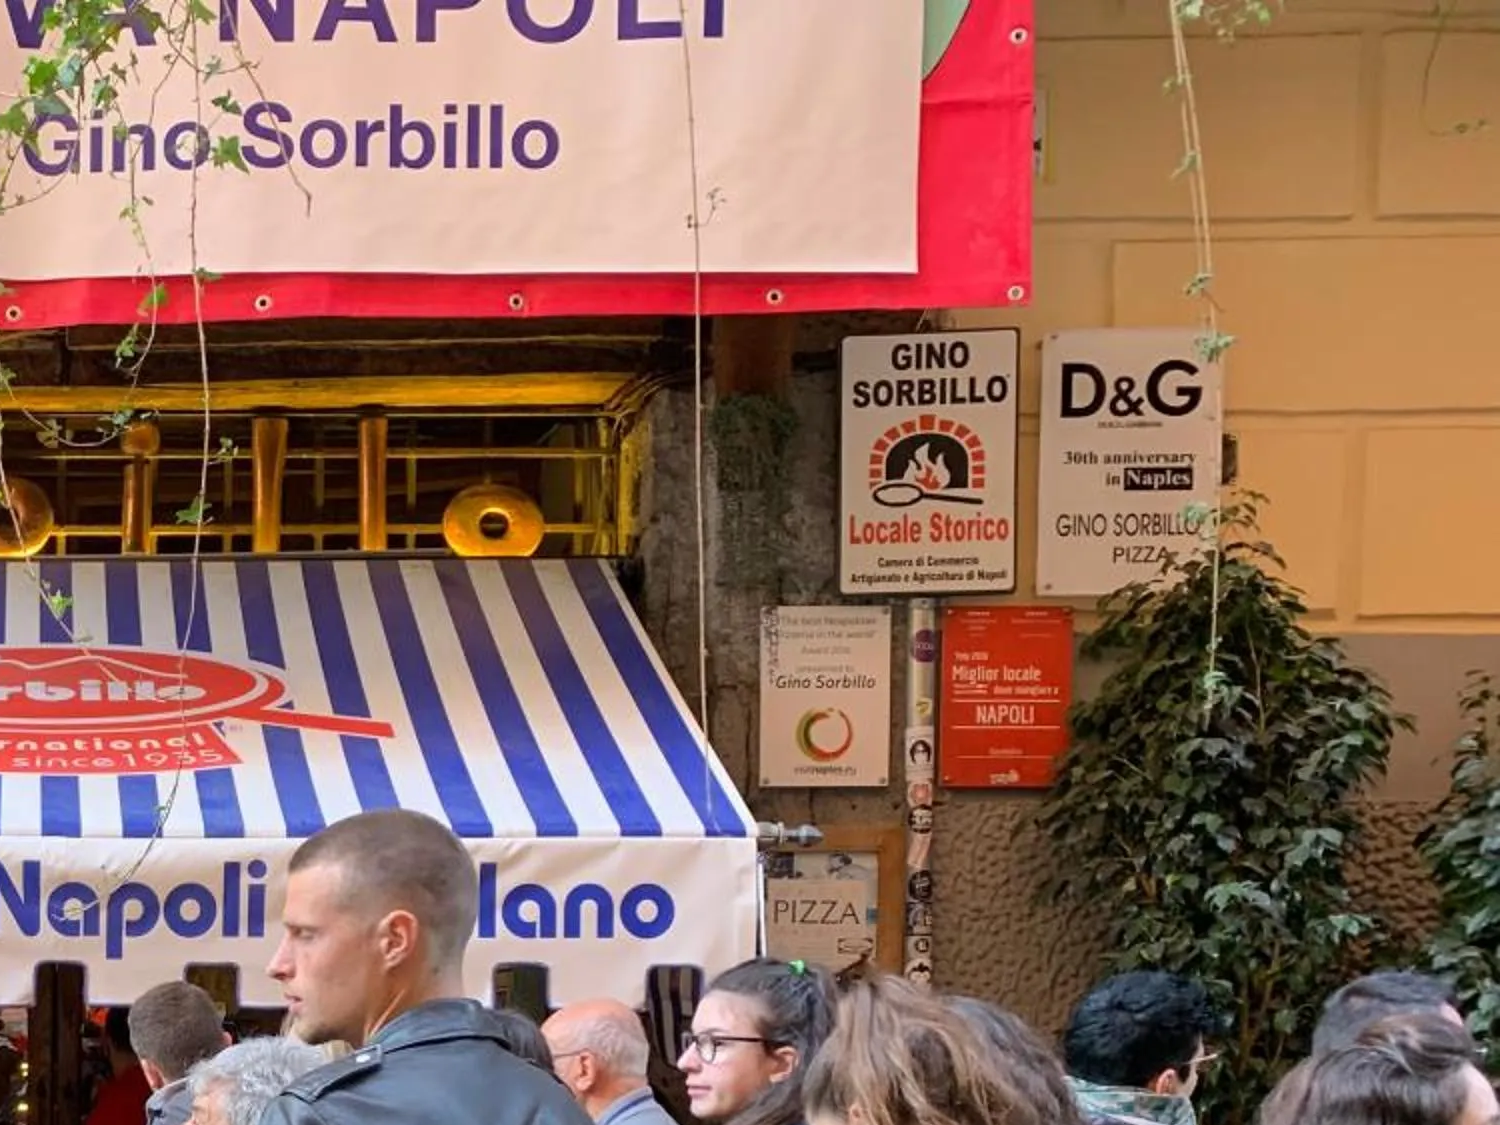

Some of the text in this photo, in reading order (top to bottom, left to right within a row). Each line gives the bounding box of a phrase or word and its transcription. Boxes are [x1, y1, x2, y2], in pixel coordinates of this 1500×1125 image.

[22, 101, 560, 177] Gino Sorbillo
[890, 340, 970, 371] GINO
[852, 375, 1008, 408] SORBILLO
[1059, 360, 1203, 418] D&G
[1063, 451, 1197, 467] 30th anniversary
[1106, 469, 1193, 489] in Naples
[850, 511, 1010, 545] Locale Storico
[1056, 513, 1107, 537] GINO
[877, 555, 980, 568] Camera di Commercio
[1112, 546, 1170, 563] PIZZA
[851, 573, 902, 586] Artigianato
[913, 571, 963, 584] Agricoltura
[966, 570, 975, 581] di
[978, 569, 1007, 582] Napoli
[776, 674, 877, 689] Gino Sorbillo
[952, 664, 1042, 684] Miglior locale
[976, 704, 1035, 724] NAPOLI
[477, 863, 675, 939] lano
[773, 900, 860, 925] PIZZA
